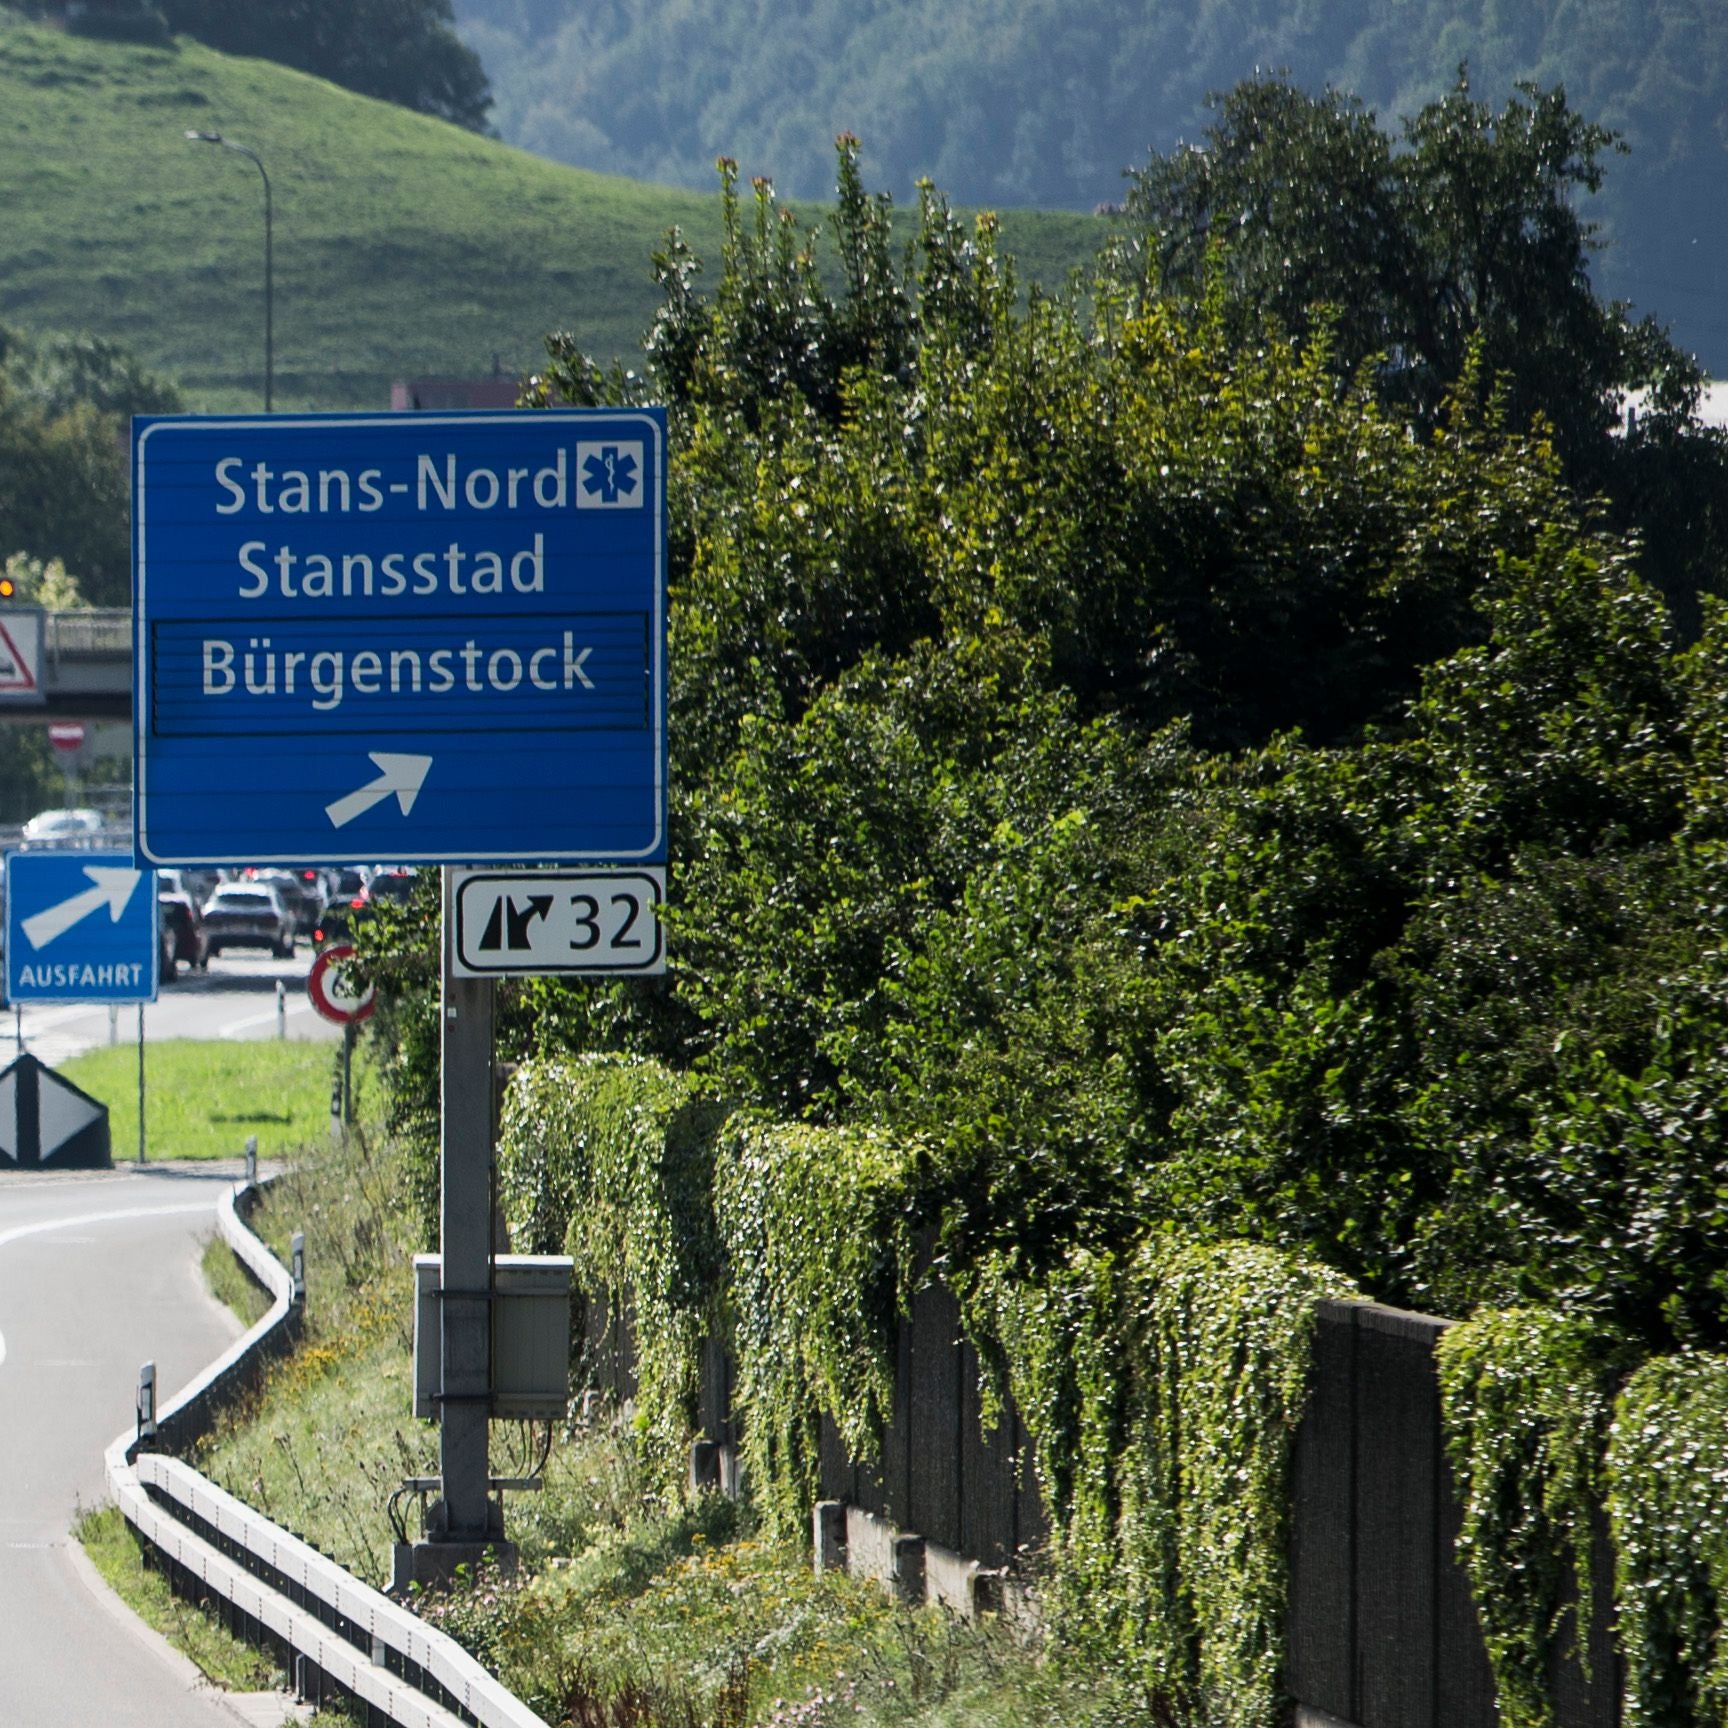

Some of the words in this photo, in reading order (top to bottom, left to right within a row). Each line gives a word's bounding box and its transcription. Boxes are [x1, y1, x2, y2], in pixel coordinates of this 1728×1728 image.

[215, 448, 567, 514] Stans-Nord
[238, 533, 545, 598] Stansstad
[201, 631, 596, 711] Bürgenstock
[569, 893, 642, 950] 32
[19, 963, 143, 988] AUSFAHRT
